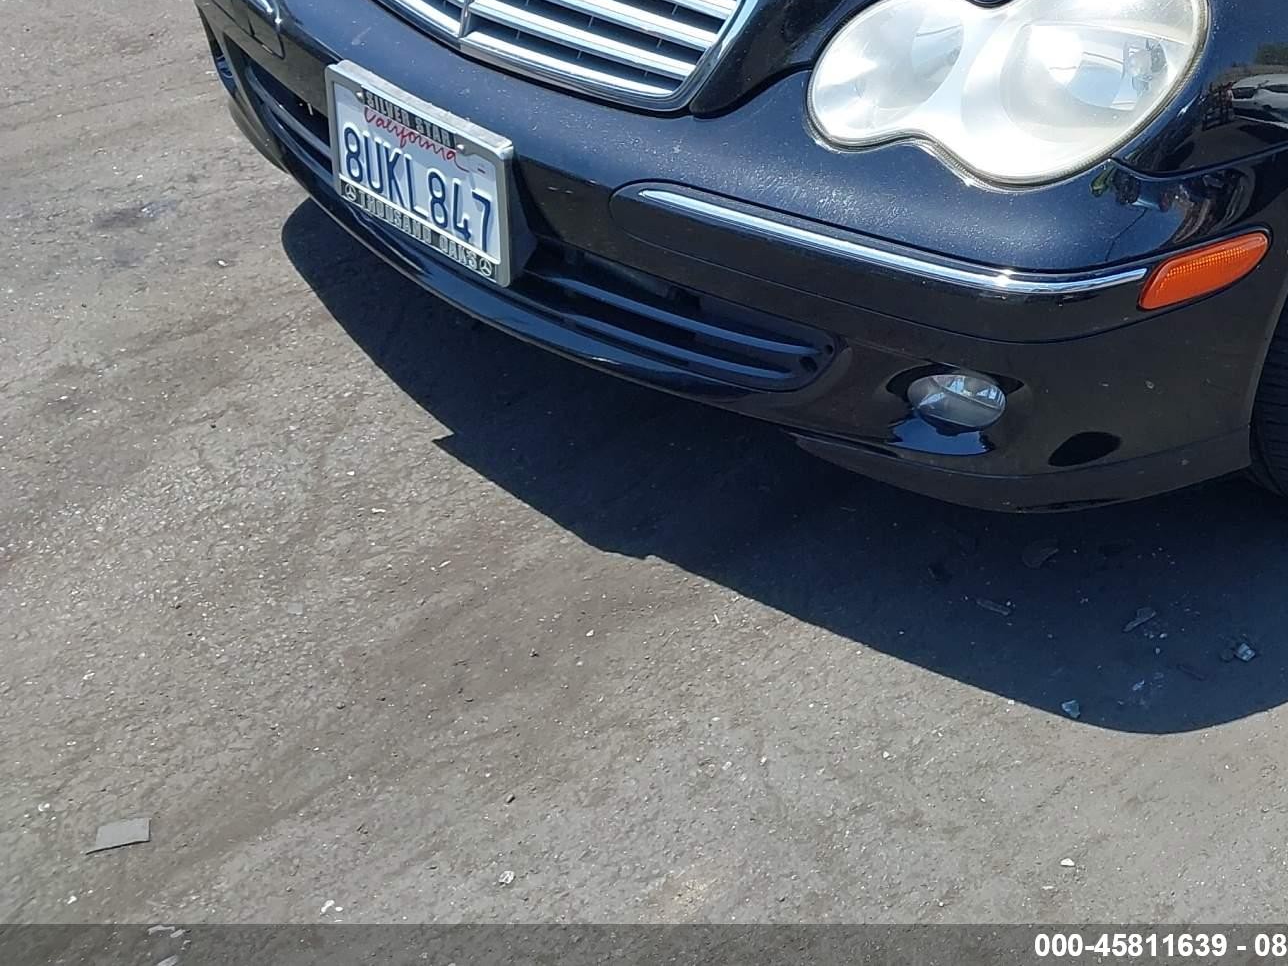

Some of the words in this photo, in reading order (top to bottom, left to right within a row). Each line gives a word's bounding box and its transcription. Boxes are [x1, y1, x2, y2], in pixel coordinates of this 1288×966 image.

[364, 107, 469, 173] California
[365, 93, 410, 128] SILVER
[414, 117, 451, 147] STAR
[344, 125, 491, 253] 8UKL847
[358, 189, 432, 245] THOUSAND
[439, 234, 478, 270] OAKS
